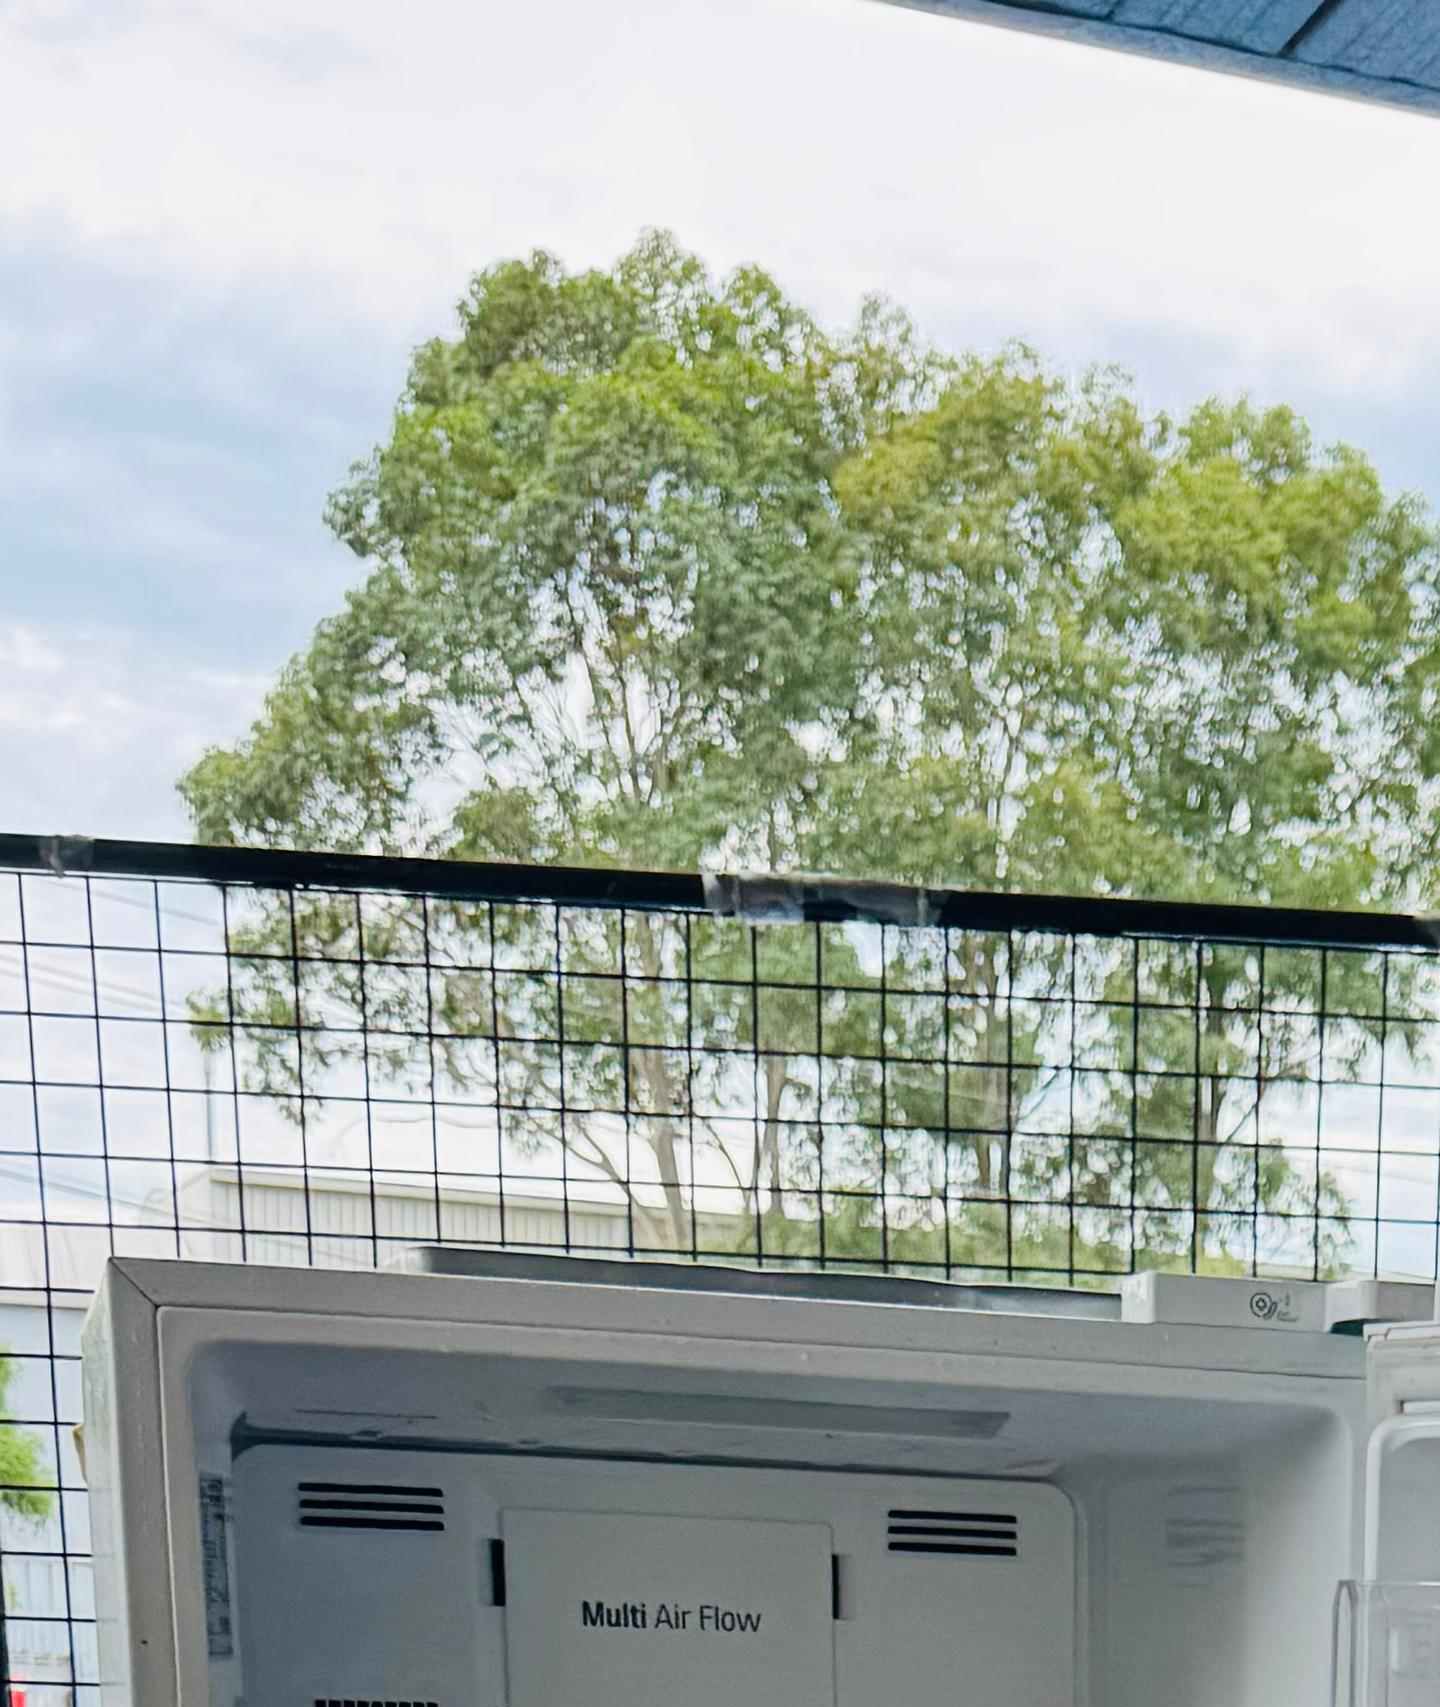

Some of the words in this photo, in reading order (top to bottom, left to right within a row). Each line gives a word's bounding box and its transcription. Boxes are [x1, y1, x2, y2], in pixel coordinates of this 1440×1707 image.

[582, 1601, 647, 1629] Multi
[654, 1604, 692, 1630] Air
[700, 1605, 762, 1632] Flow
